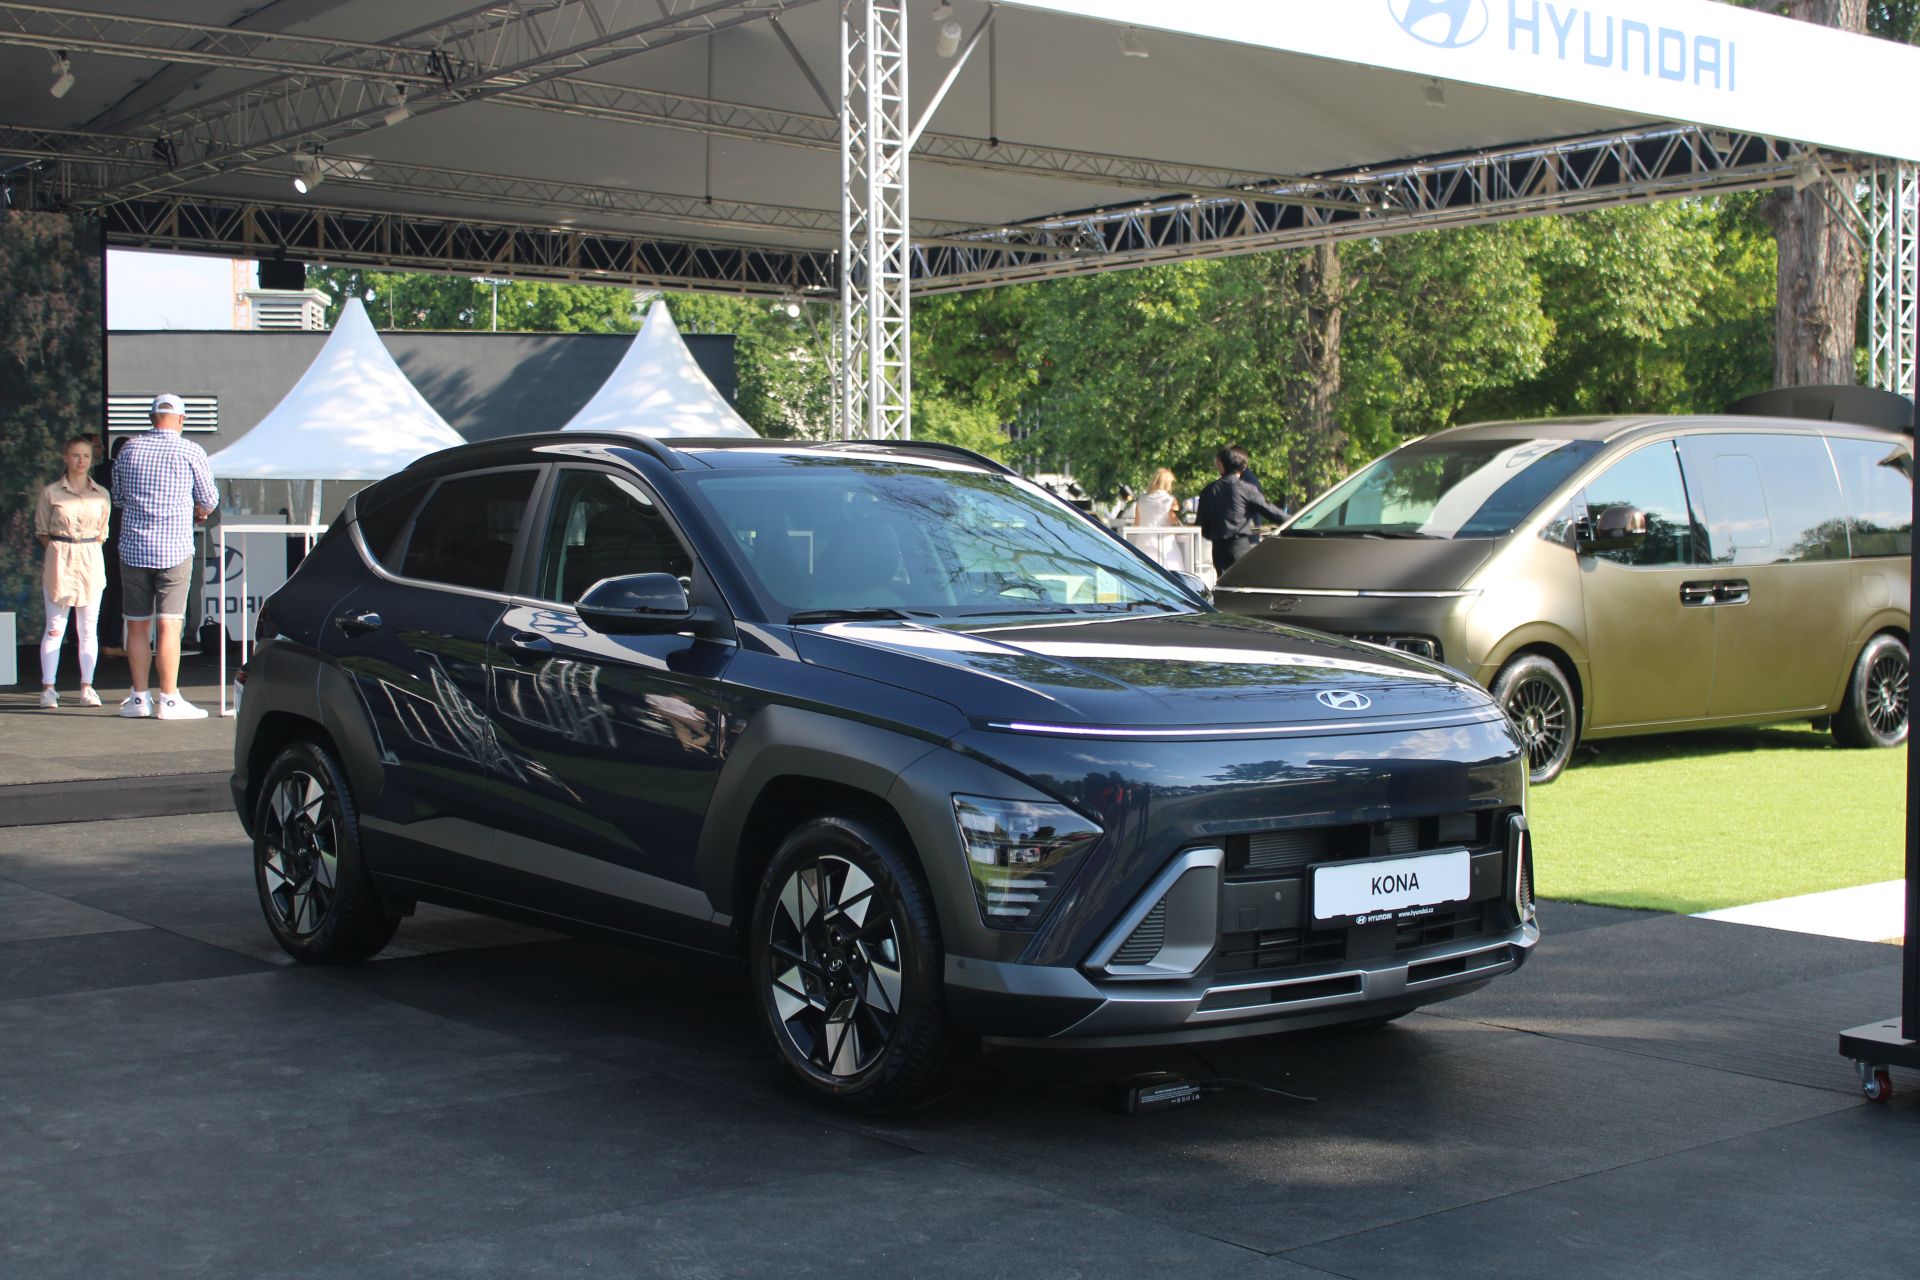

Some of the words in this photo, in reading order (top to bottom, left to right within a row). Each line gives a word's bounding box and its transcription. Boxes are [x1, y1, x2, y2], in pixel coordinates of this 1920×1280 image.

[1508, 0, 1735, 92] HYUNDAI
[206, 596, 263, 613] NDAI
[1371, 872, 1419, 895] KONA
[1368, 912, 1393, 922] HYUNDAI
